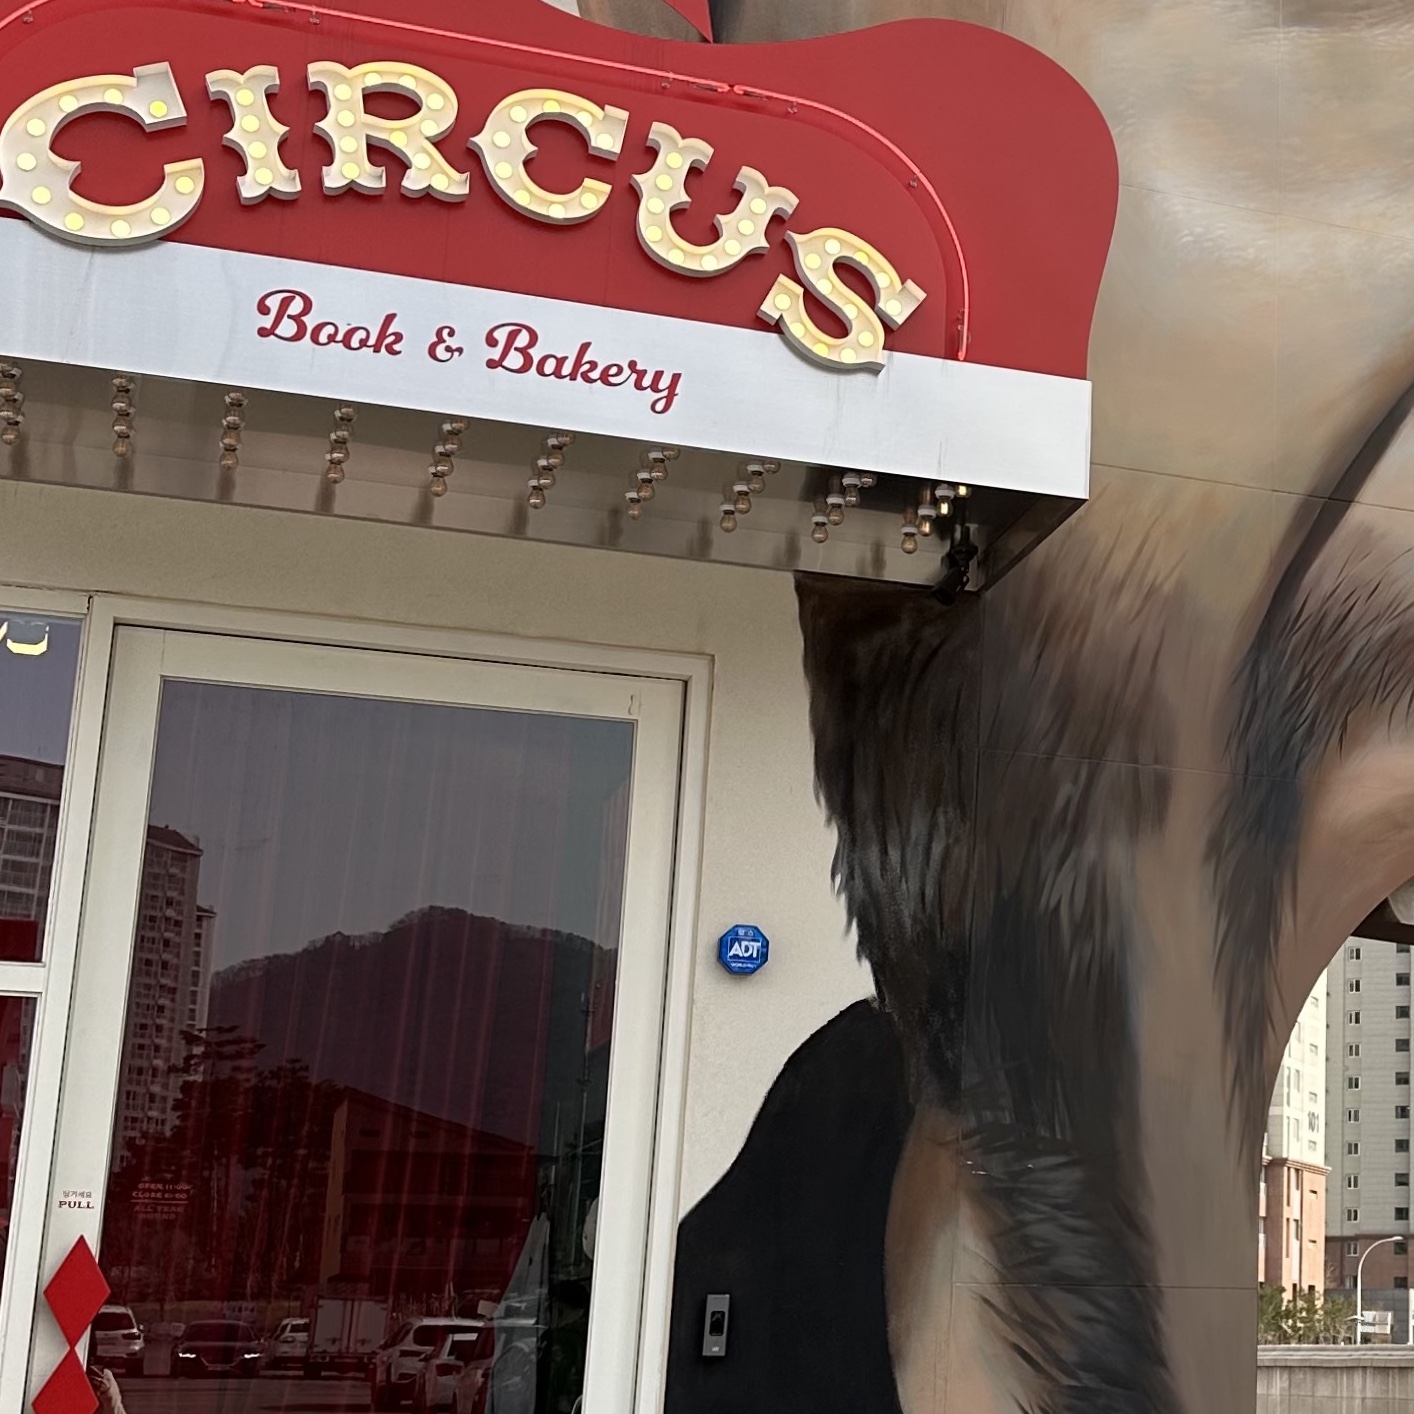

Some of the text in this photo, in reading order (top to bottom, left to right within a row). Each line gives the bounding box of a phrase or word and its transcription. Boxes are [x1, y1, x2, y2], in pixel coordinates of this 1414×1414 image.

[0, 61, 928, 374] CIRCUS
[256, 288, 683, 414] Book & Bakery
[729, 941, 761, 957] ADT
[58, 1200, 94, 1209] PULL
